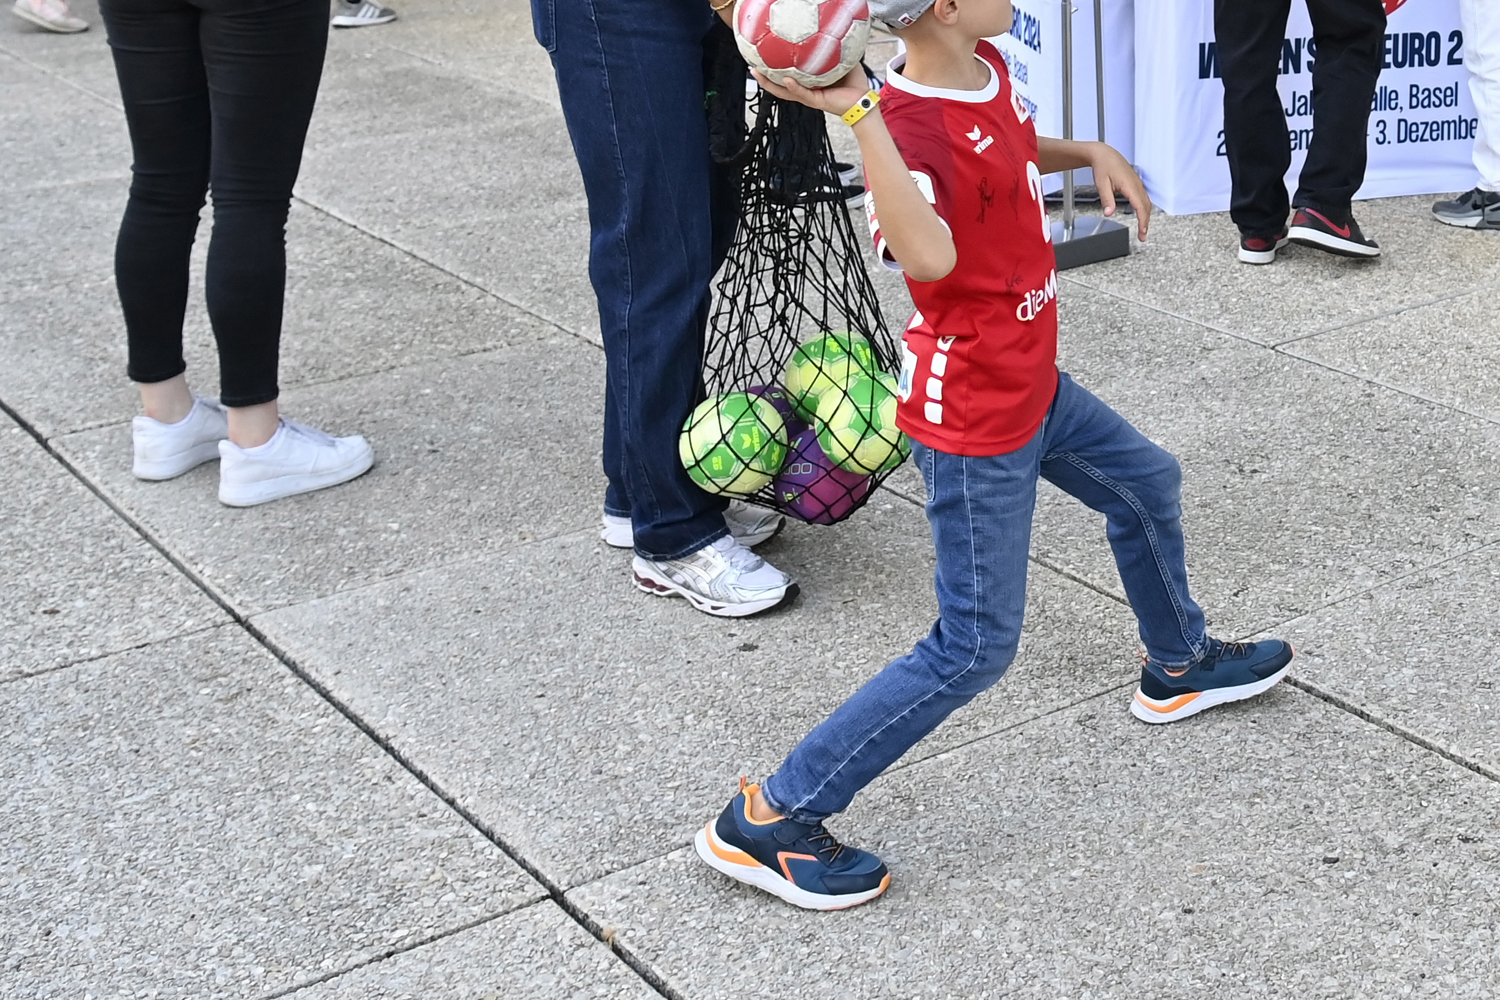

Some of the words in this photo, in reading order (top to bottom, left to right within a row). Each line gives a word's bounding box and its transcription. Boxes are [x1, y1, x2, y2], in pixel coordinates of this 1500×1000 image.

[1023, 11, 1042, 54] 2024
[1382, 31, 1442, 69] EURO
[1408, 81, 1459, 109] Basel
[1375, 120, 1391, 145] 3.
[1397, 115, 1478, 143] Dezembe
